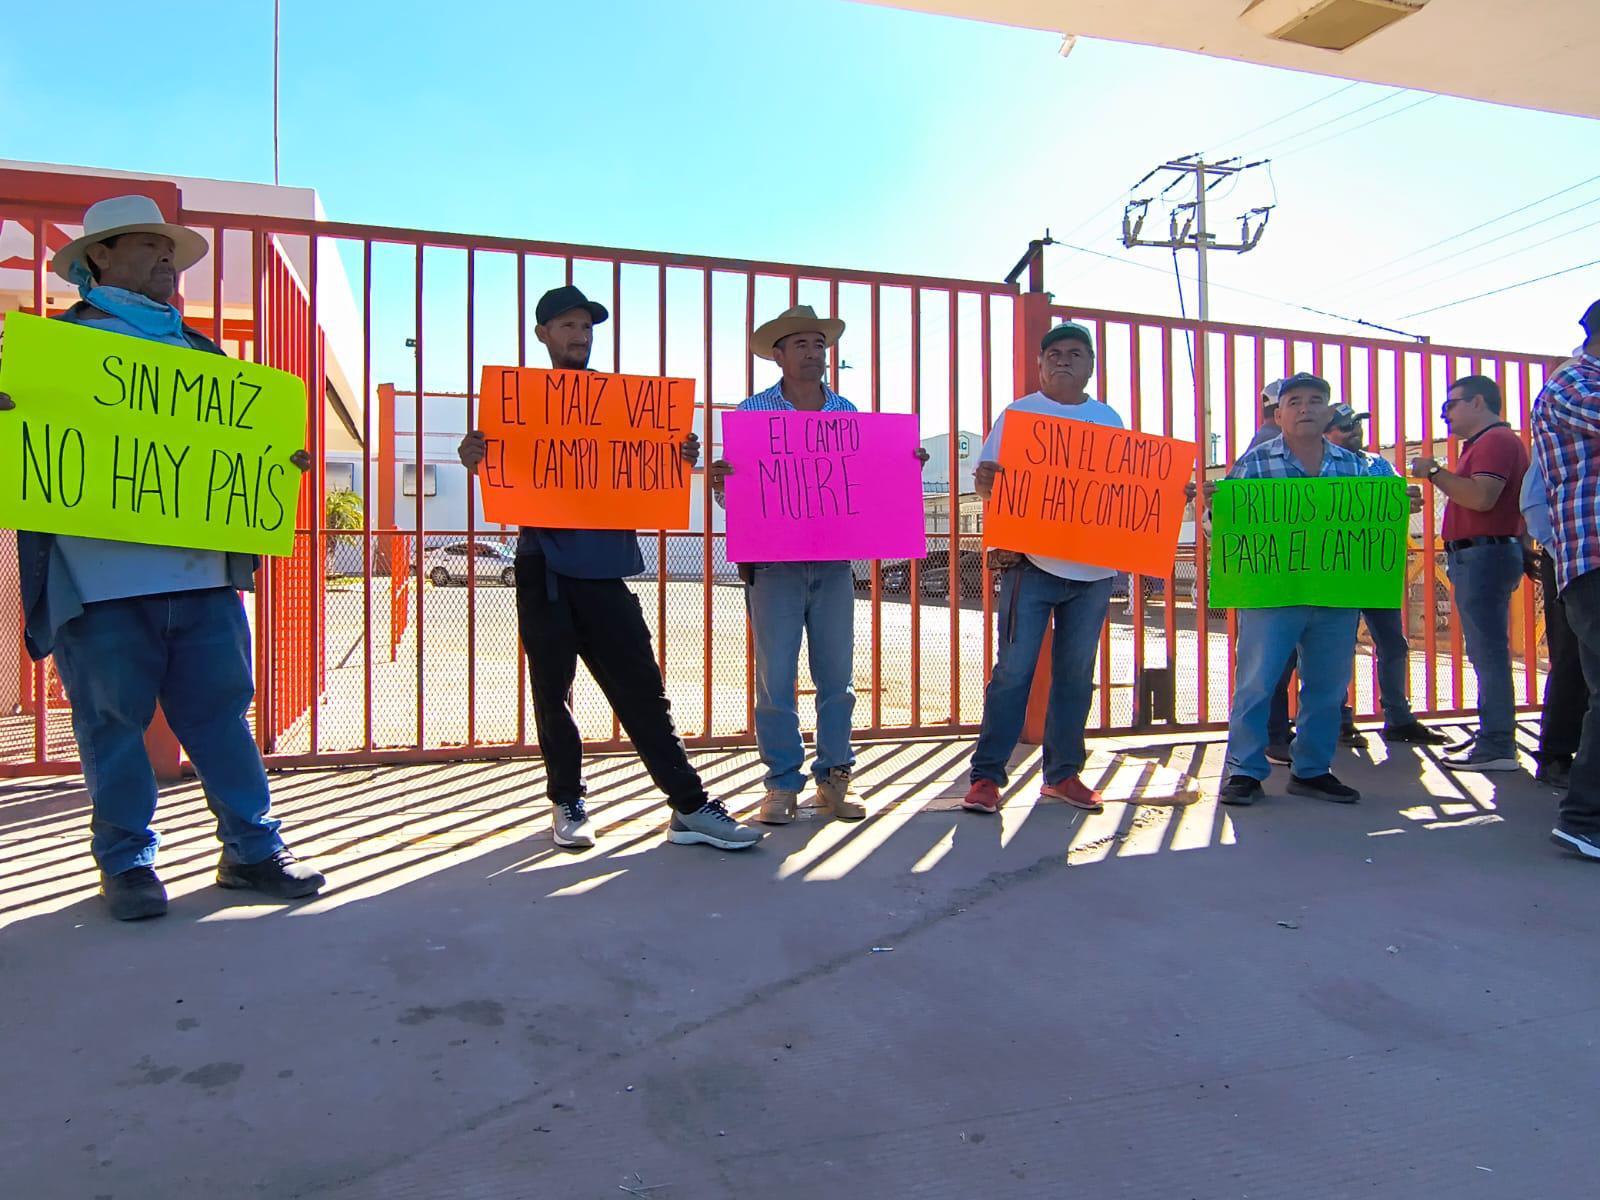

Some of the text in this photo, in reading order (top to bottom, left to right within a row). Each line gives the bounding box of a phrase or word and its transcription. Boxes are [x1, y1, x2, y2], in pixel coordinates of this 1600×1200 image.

[93, 355, 262, 430] SIN MAÍZ
[501, 370, 680, 432] EL MAÍZ VALE
[484, 435, 684, 491] EL CAMPO TAMBIÉN
[769, 416, 860, 455] EL CAMPO
[1025, 420, 1172, 481] SIN EL CAMPO
[22, 421, 285, 531] NO HAY PAÍS
[758, 454, 862, 520] MUERE
[997, 467, 1161, 534] NO HAY COMIDA
[1231, 481, 1403, 525] PRECIOS JUSTOS
[1221, 527, 1397, 575] PARA EL CAMPO
